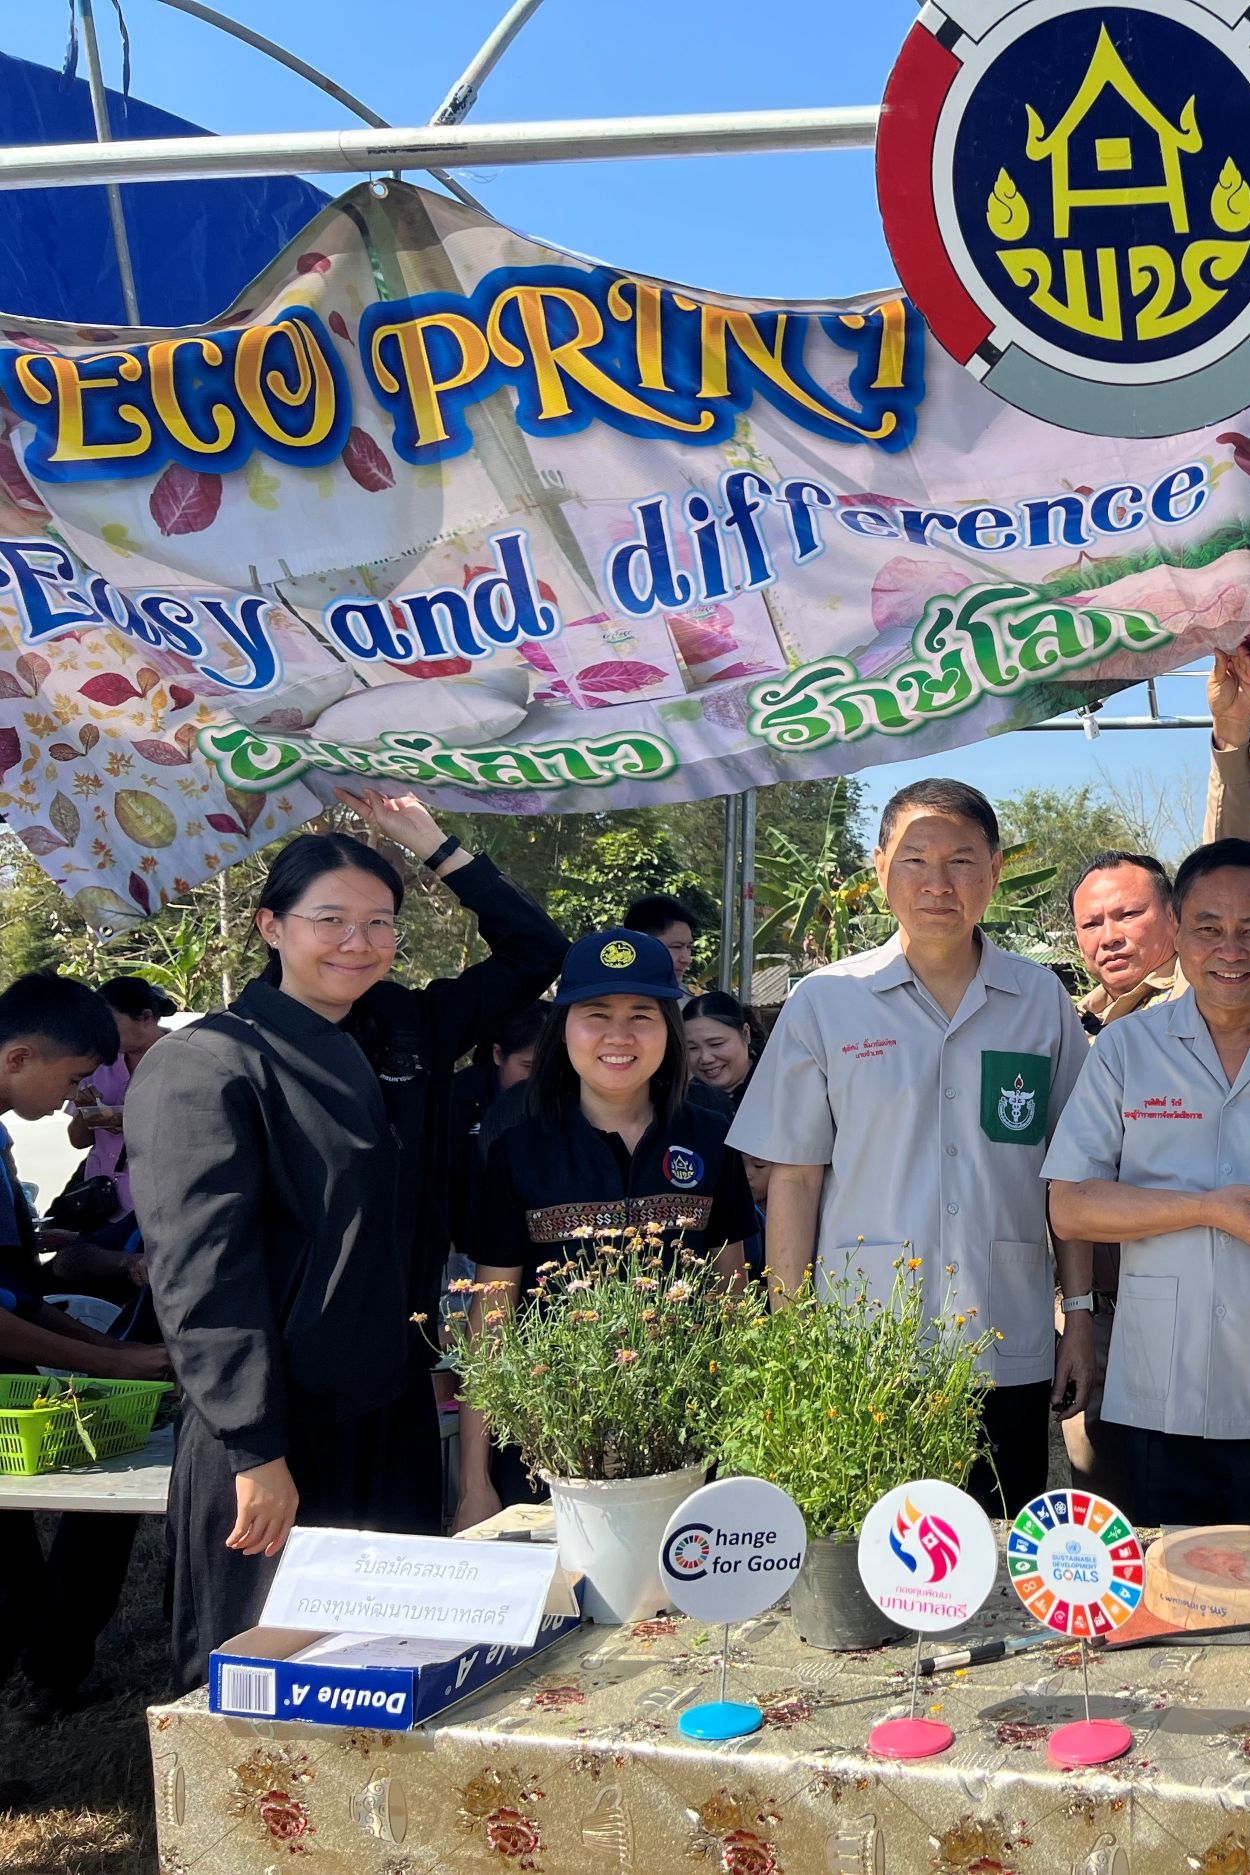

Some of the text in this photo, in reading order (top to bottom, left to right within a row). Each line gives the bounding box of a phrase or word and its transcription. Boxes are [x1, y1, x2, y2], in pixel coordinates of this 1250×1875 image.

[15, 317, 336, 463] ECO
[0, 462, 1207, 690] Easy and difference
[353, 1553, 479, 1582] รับสมัครสมาชิก
[711, 1552, 802, 1574] for Good
[1051, 1554, 1097, 1562] SUSTAINABLE
[1052, 1561, 1098, 1570] DEVELOPMENT
[1053, 1568, 1100, 1583] GOALS
[296, 1597, 511, 1626] กองทุนพัฒนาบทบาทสตรี
[879, 1595, 968, 1619] บทบาทสตรี
[318, 1688, 407, 1714] Double
